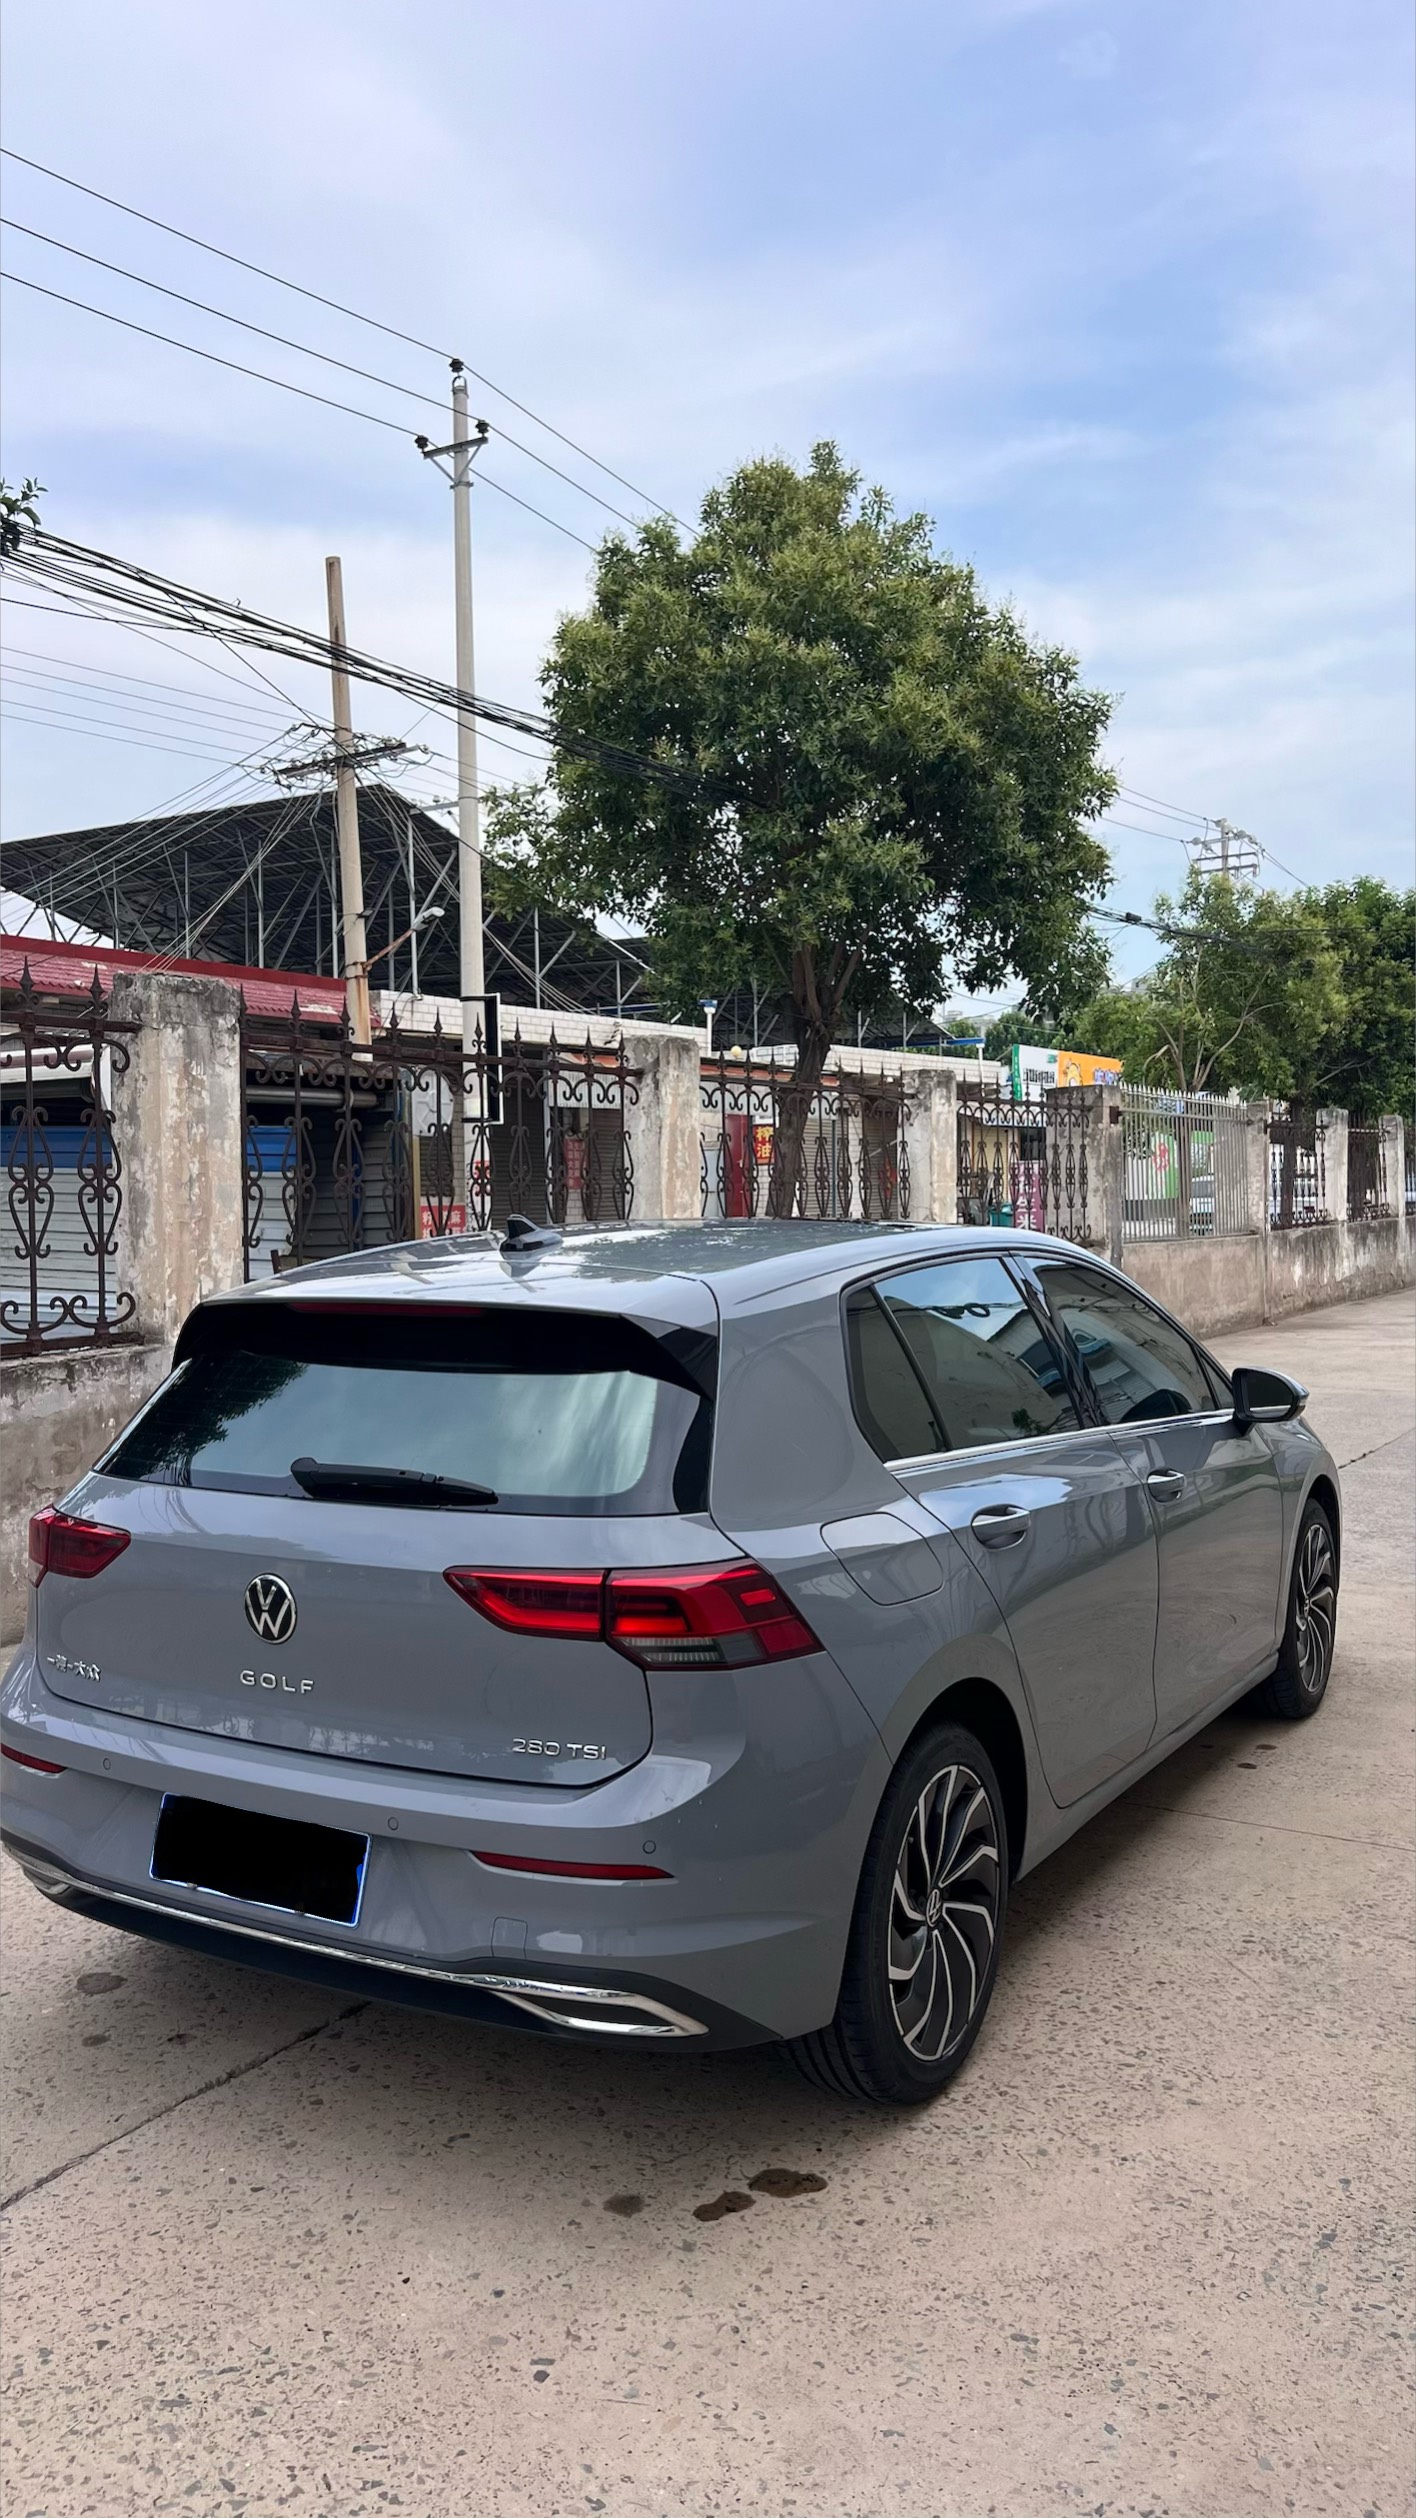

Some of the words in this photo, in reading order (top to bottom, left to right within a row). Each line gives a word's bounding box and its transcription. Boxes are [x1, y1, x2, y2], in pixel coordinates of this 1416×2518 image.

[240, 1669, 314, 1694] GOLF
[512, 1738, 560, 1756] 280
[566, 1743, 606, 1760] TSI
